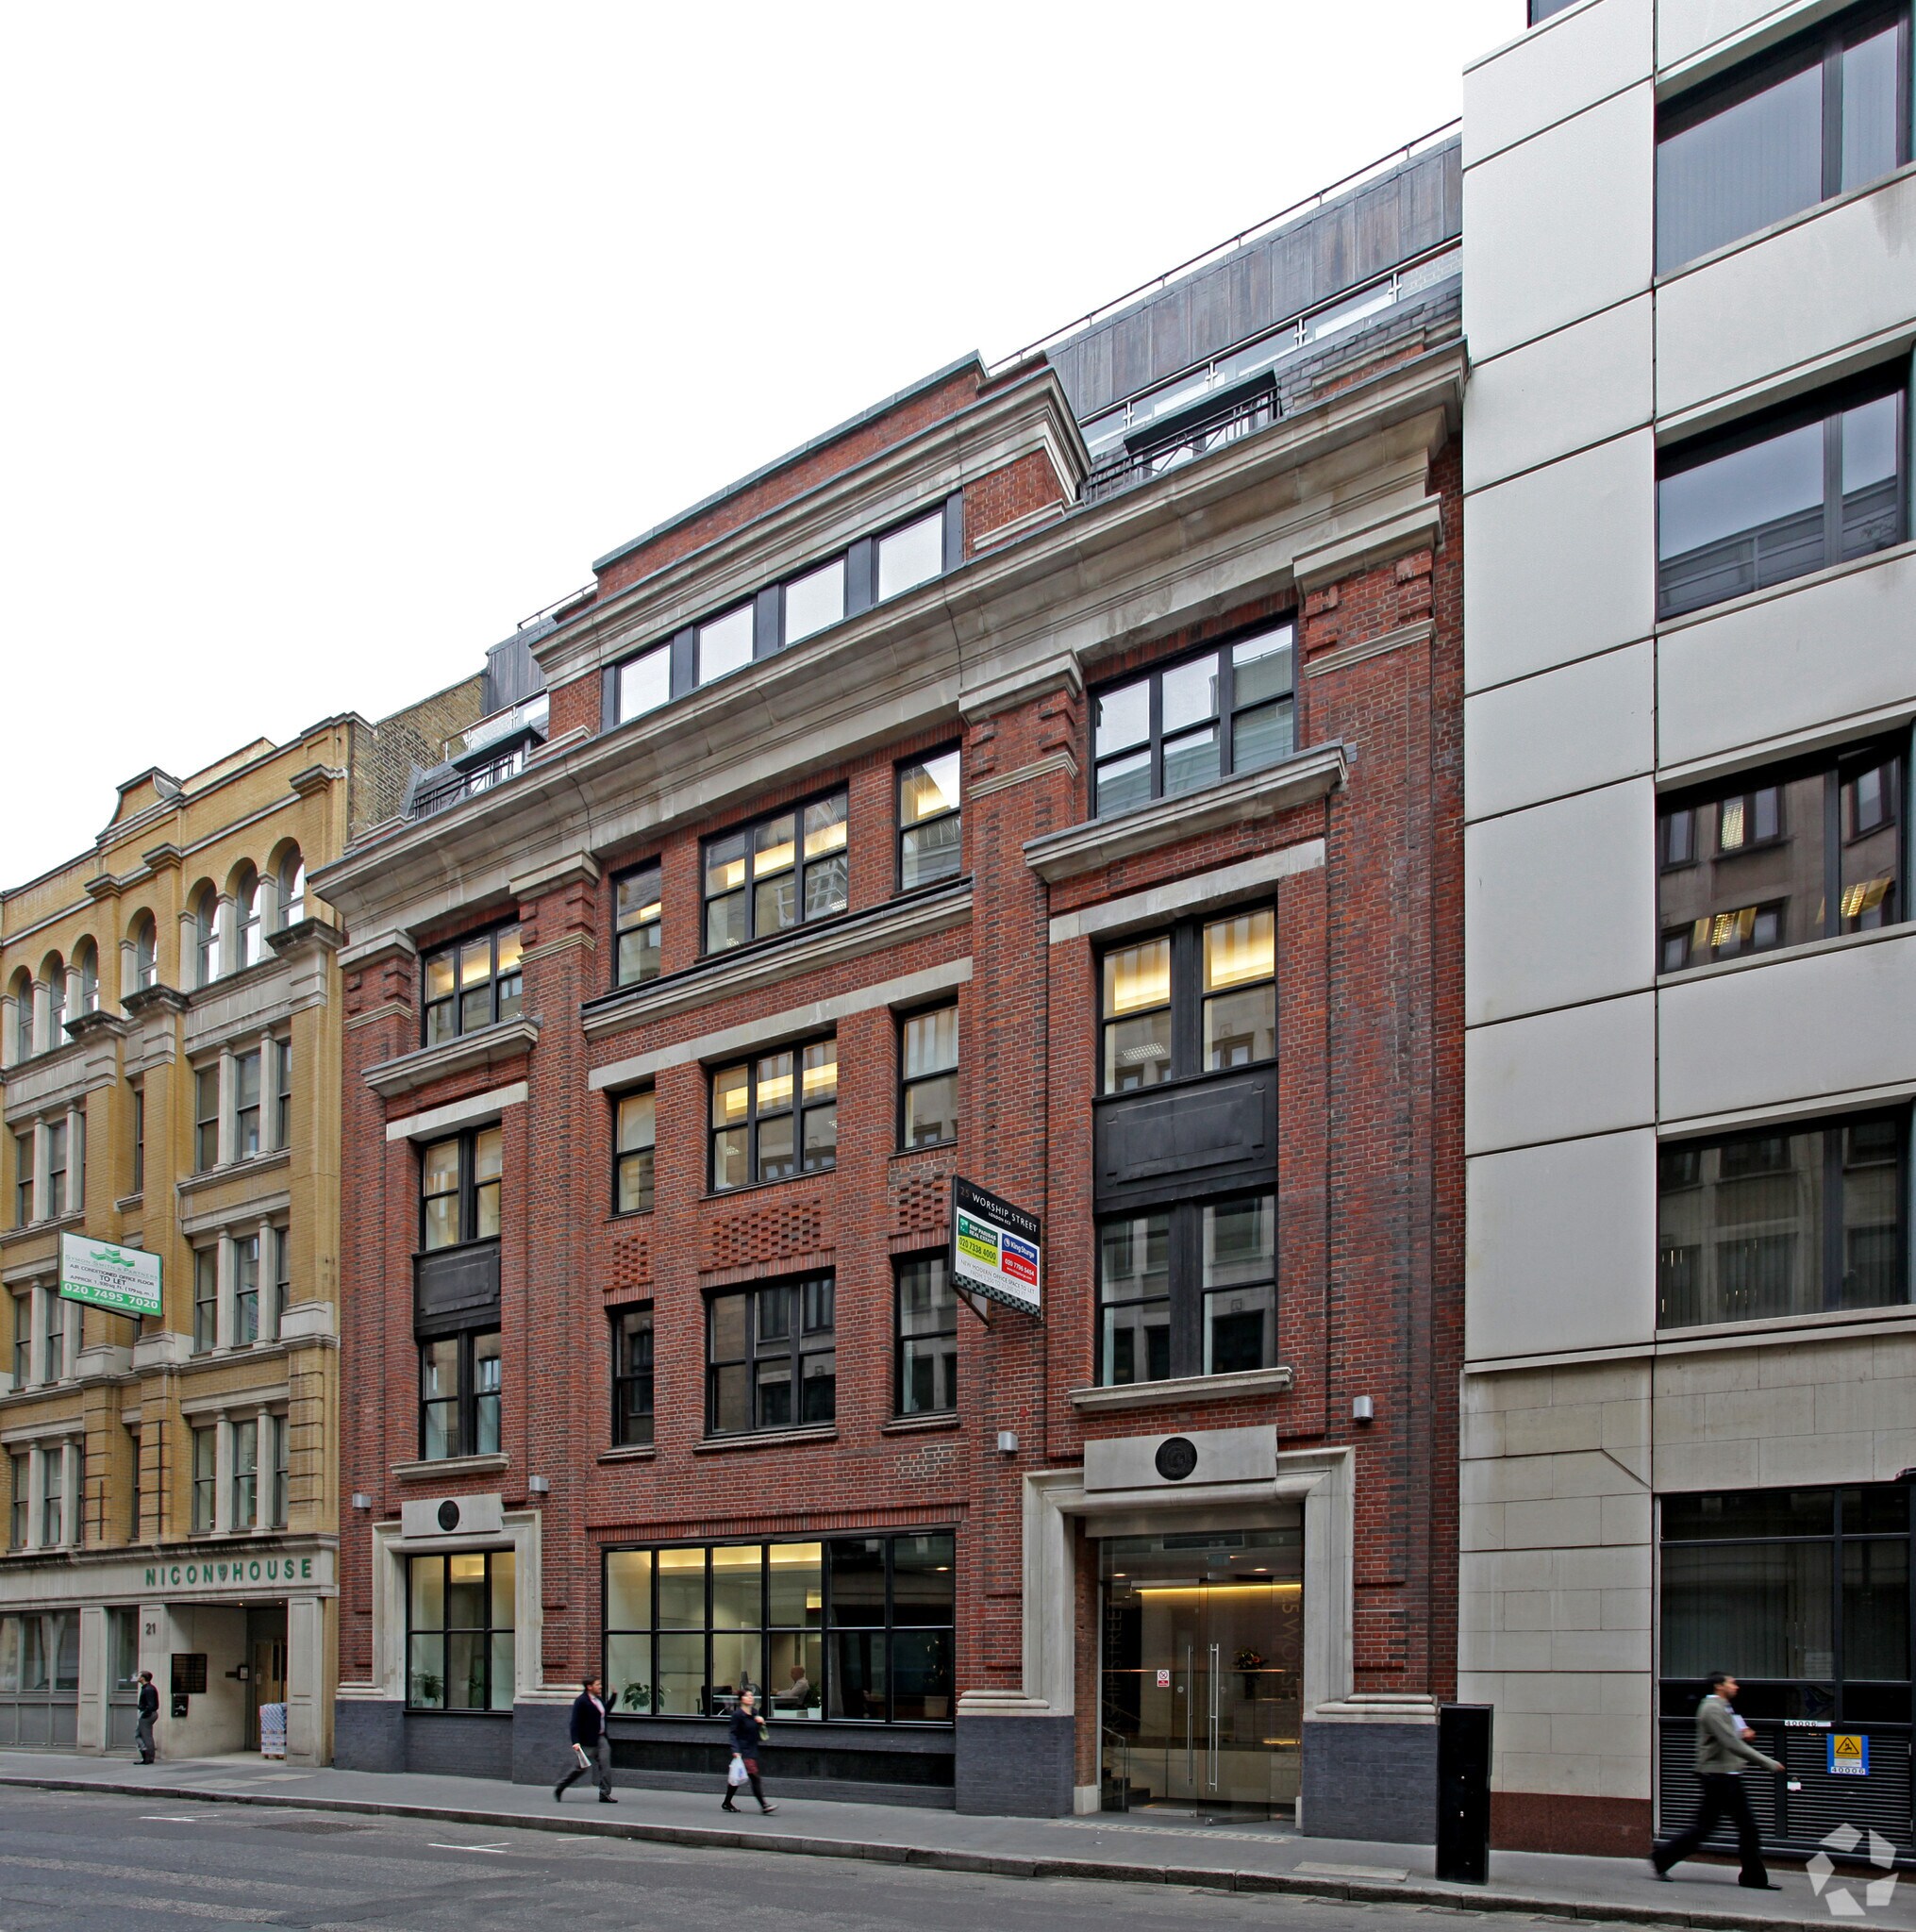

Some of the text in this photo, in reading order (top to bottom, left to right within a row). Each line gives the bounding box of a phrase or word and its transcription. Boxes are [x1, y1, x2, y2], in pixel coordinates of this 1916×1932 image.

[960, 1186, 1037, 1233] 25 WORSHIP STREET
[988, 1212, 1004, 1223] LONDON
[958, 1237, 969, 1248] 020
[80, 1265, 118, 1278] CONDITIONED
[118, 1274, 136, 1283] OFFICE
[992, 1273, 1008, 1284] OFFICE
[64, 1283, 158, 1309] 020 7495 7020
[145, 1558, 312, 1586] NICON HOUSE
[145, 1623, 157, 1636] 21
[1831, 1766, 1864, 1774] 40006
